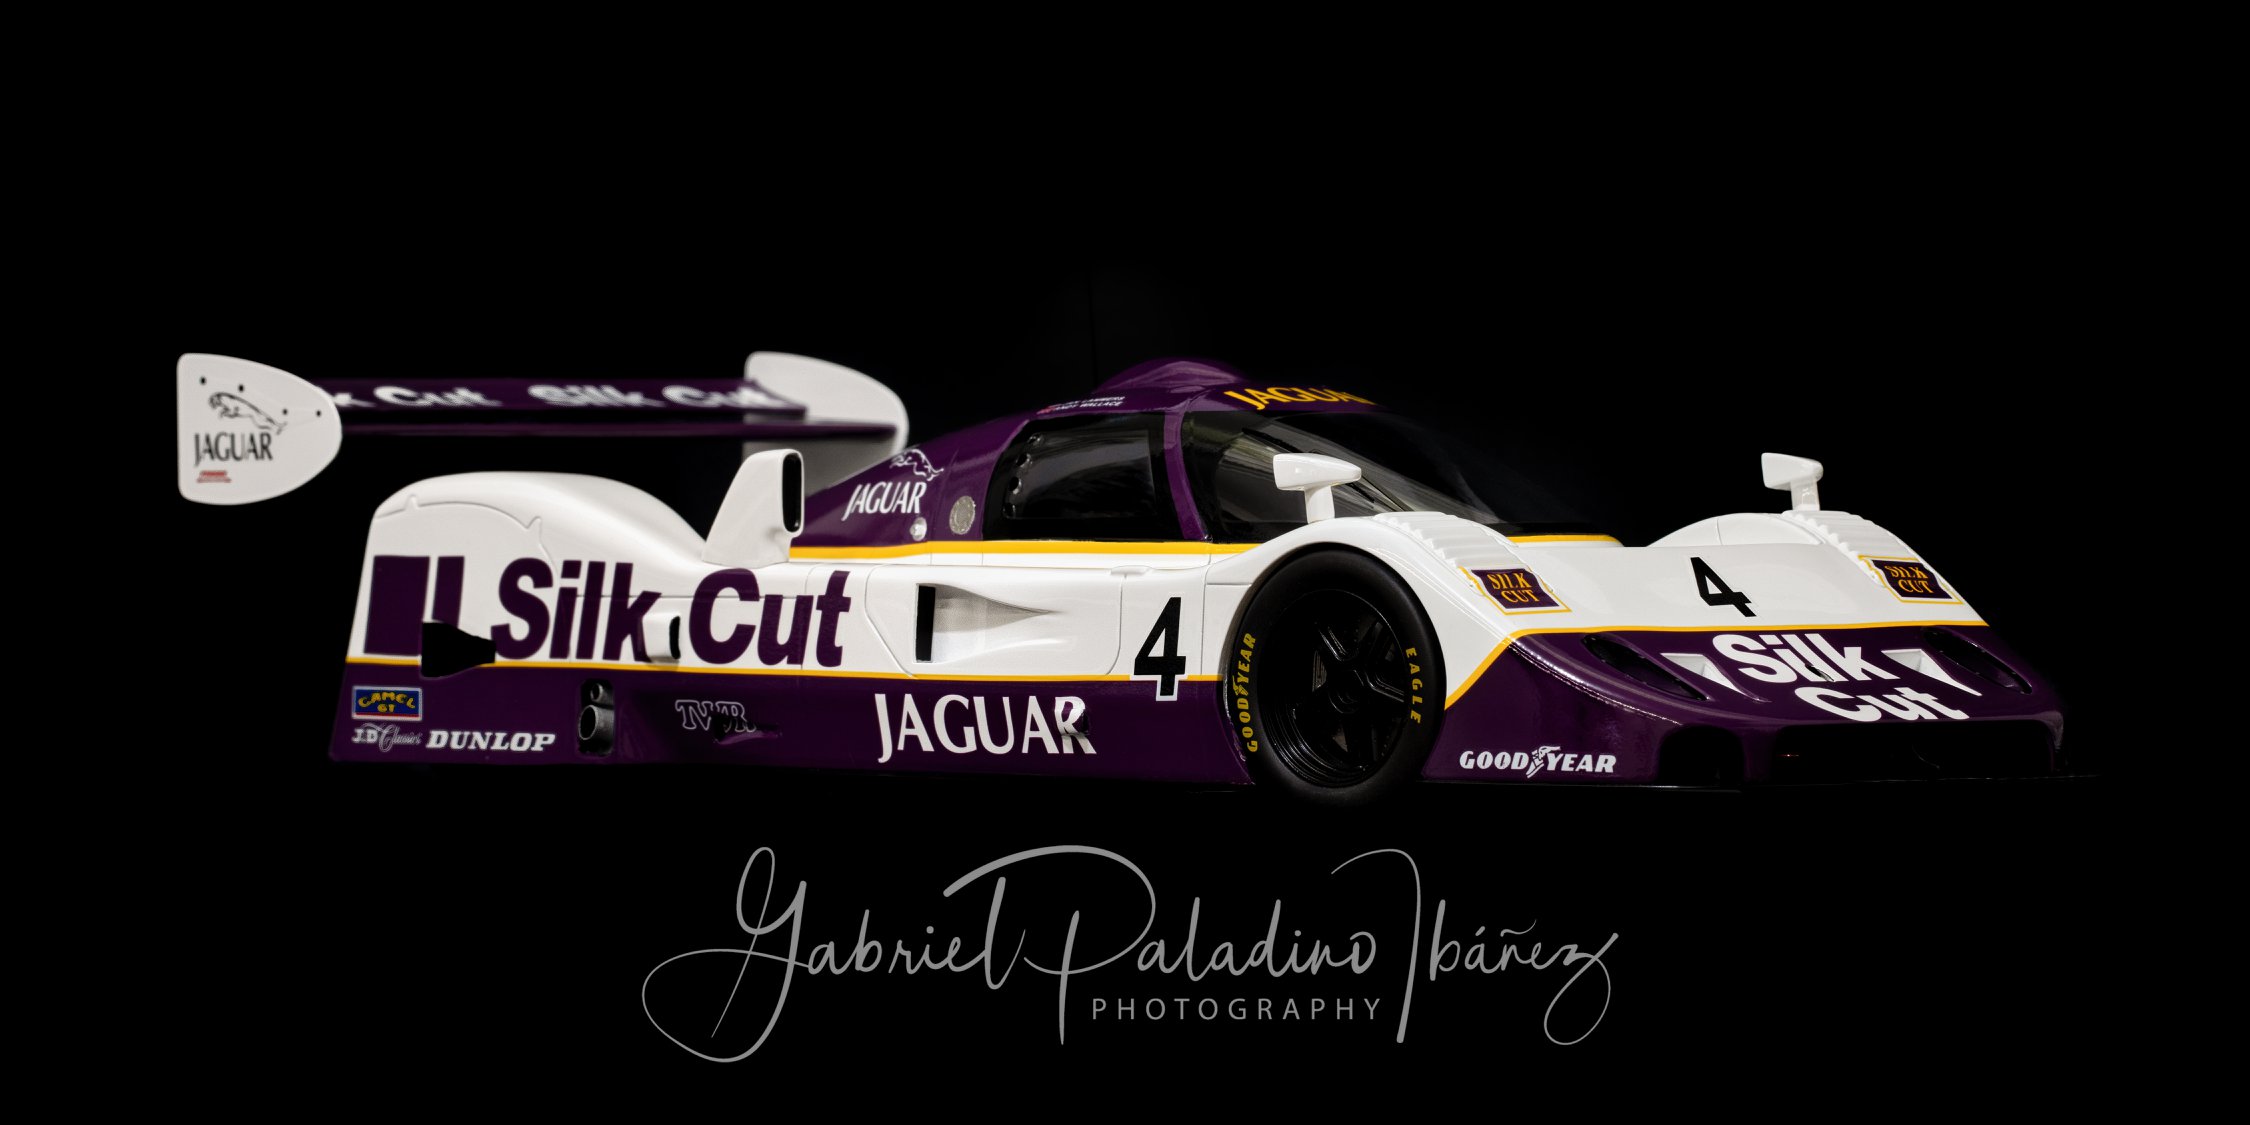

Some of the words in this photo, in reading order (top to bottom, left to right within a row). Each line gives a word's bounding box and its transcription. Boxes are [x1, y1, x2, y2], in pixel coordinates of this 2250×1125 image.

[194, 431, 273, 466] JAGUAR
[841, 481, 928, 522] JAGUAR
[1486, 572, 1533, 590] SILK
[1690, 556, 1757, 618] 4
[1883, 565, 1929, 580] SILK
[1897, 579, 1935, 594] CUT
[491, 557, 661, 661] Silk
[689, 568, 852, 668] Cut
[1500, 588, 1541, 603] CUT
[1133, 596, 1187, 698] 4
[1711, 632, 1901, 684] Silk
[358, 691, 416, 709] CAMEL
[1405, 647, 1423, 724] EAGLE
[377, 703, 395, 713] GT
[1794, 686, 1971, 723] Cut
[425, 730, 556, 752] DUNLOP
[874, 693, 1097, 764] JAGUAR
